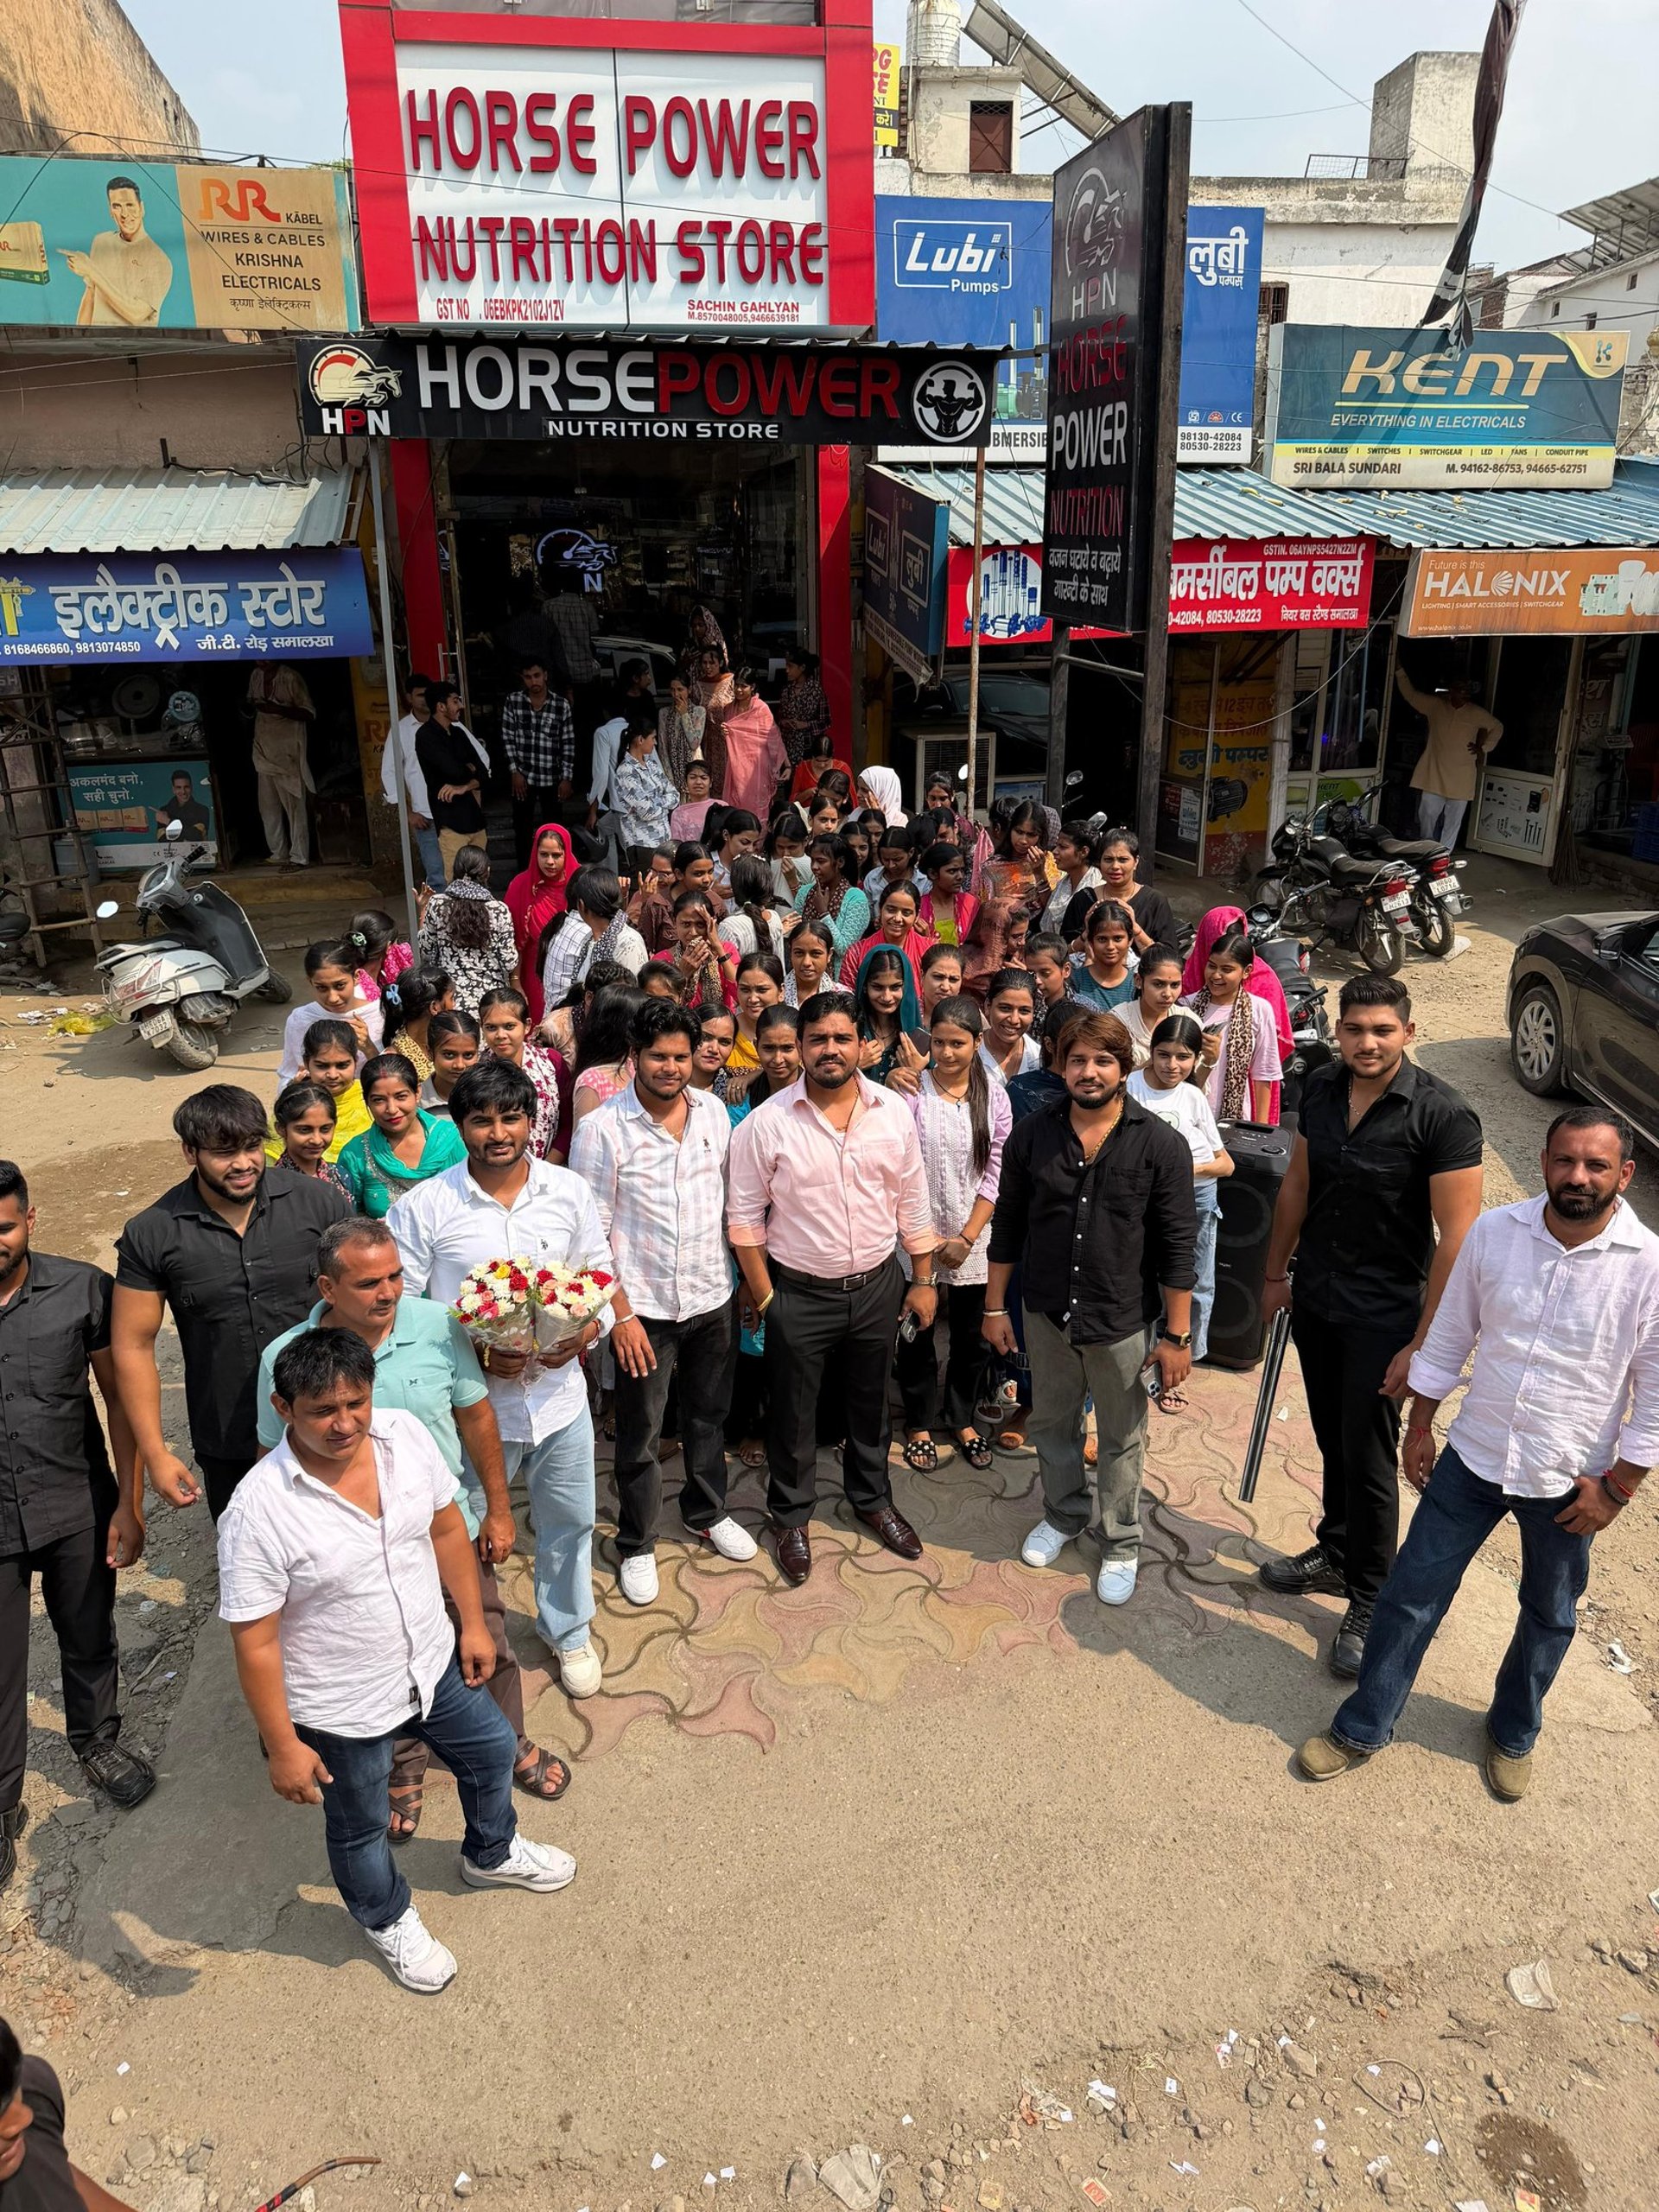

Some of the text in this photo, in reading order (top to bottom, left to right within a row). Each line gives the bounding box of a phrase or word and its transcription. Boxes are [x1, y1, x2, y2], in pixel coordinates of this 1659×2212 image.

[407, 86, 821, 180] HORSE POWER
[200, 178, 282, 223] RR
[201, 231, 326, 247] WIRES & CABLES
[416, 215, 824, 285] NUTRITION STORE
[235, 252, 304, 269] KRISHNA
[906, 231, 1001, 273] Lubi
[1186, 226, 1249, 286] लुबी
[222, 275, 321, 291] ELECTRICALS
[950, 278, 1000, 296] Pumps
[688, 299, 799, 313] SACHIN GAHLYAN
[1071, 268, 1116, 322] HPN
[436, 298, 454, 321] GST
[456, 298, 470, 321] NO
[1057, 315, 1128, 397] HORSE
[1341, 350, 1568, 397] KENT
[321, 408, 391, 435] HPN
[547, 419, 780, 441] NUTRITION STORE
[1331, 413, 1526, 429] EVERYTHING IN ELECTRICALS
[1052, 401, 1128, 472] POWER
[1179, 442, 1243, 453] 80530-28223
[1180, 431, 1243, 442] 98130-42084
[1294, 462, 1587, 475] SRI BALA SUNDARI M. 94162-86753, 94665-62751
[1050, 485, 1124, 538] NUTRITION
[868, 524, 887, 561] Lubi
[1263, 545, 1288, 556] GSTIN.
[1049, 548, 1068, 569] वजन
[1090, 550, 1098, 571] व
[1429, 560, 1485, 569] Future is this
[1265, 561, 1308, 598] पम्प
[1424, 570, 1571, 598] HALONIX
[238, 561, 326, 628] स्टोर
[1079, 576, 1090, 603] के
[1090, 584, 1109, 607] साथ
[1206, 608, 1262, 624] 80530-28223
[1281, 605, 1298, 621] नियर
[1299, 608, 1311, 620] बस
[1330, 608, 1359, 620] समालखा
[4, 641, 141, 656] 8168466860, 9813074850
[196, 636, 241, 651] जी.टी.
[271, 635, 334, 650] समालखा
[82, 788, 105, 803] सही
